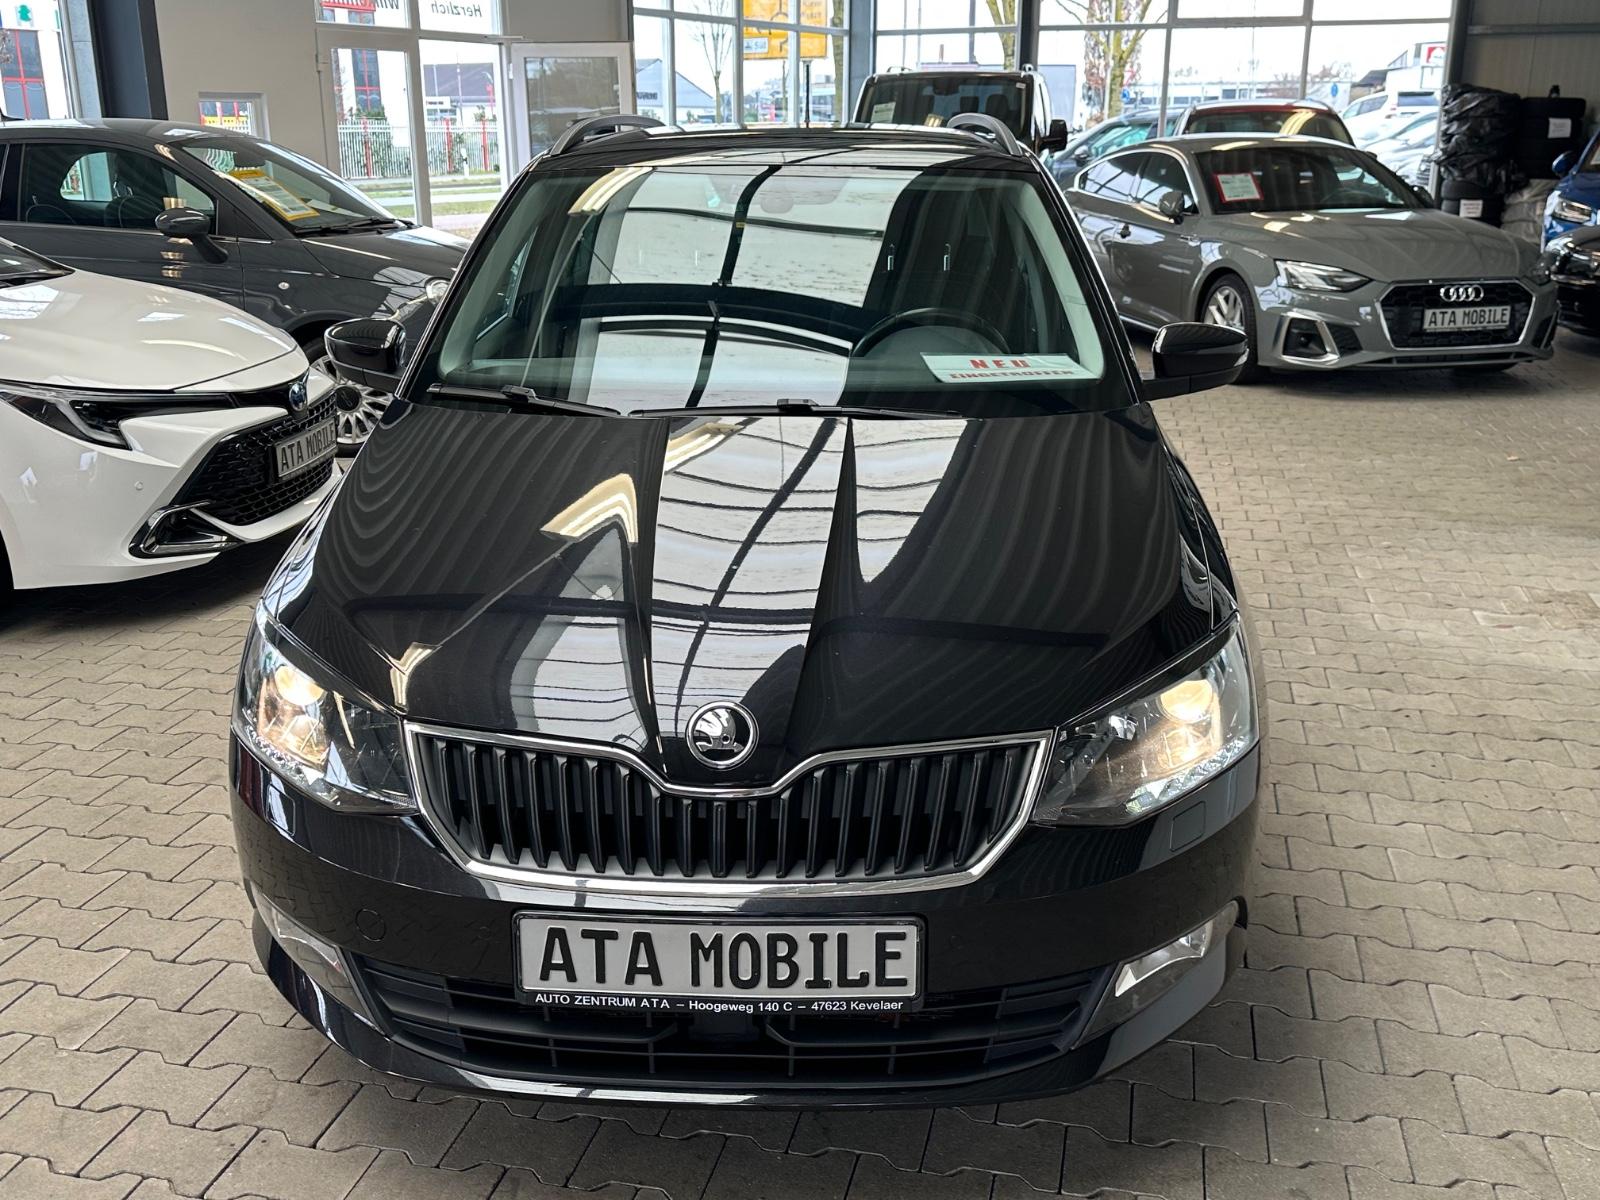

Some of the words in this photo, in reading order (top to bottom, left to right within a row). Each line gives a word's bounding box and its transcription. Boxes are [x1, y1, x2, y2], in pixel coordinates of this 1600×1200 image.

[1428, 310, 1457, 327] ATA
[1462, 308, 1509, 325] MOBILE
[969, 359, 1032, 369] NEU
[281, 440, 304, 471] ATA
[306, 422, 336, 459] MOBILE
[539, 926, 663, 986] ATA
[689, 931, 908, 989] MOBILE
[535, 993, 570, 1005] AUTO
[574, 995, 636, 1007] ZENTRUM
[640, 998, 670, 1009] ATA
[689, 1000, 754, 1013] Hoogeweg
[758, 1001, 779, 1012] 140
[783, 1001, 793, 1012] C
[811, 1001, 847, 1011] 47623
[850, 1000, 904, 1011] Kevelaer
